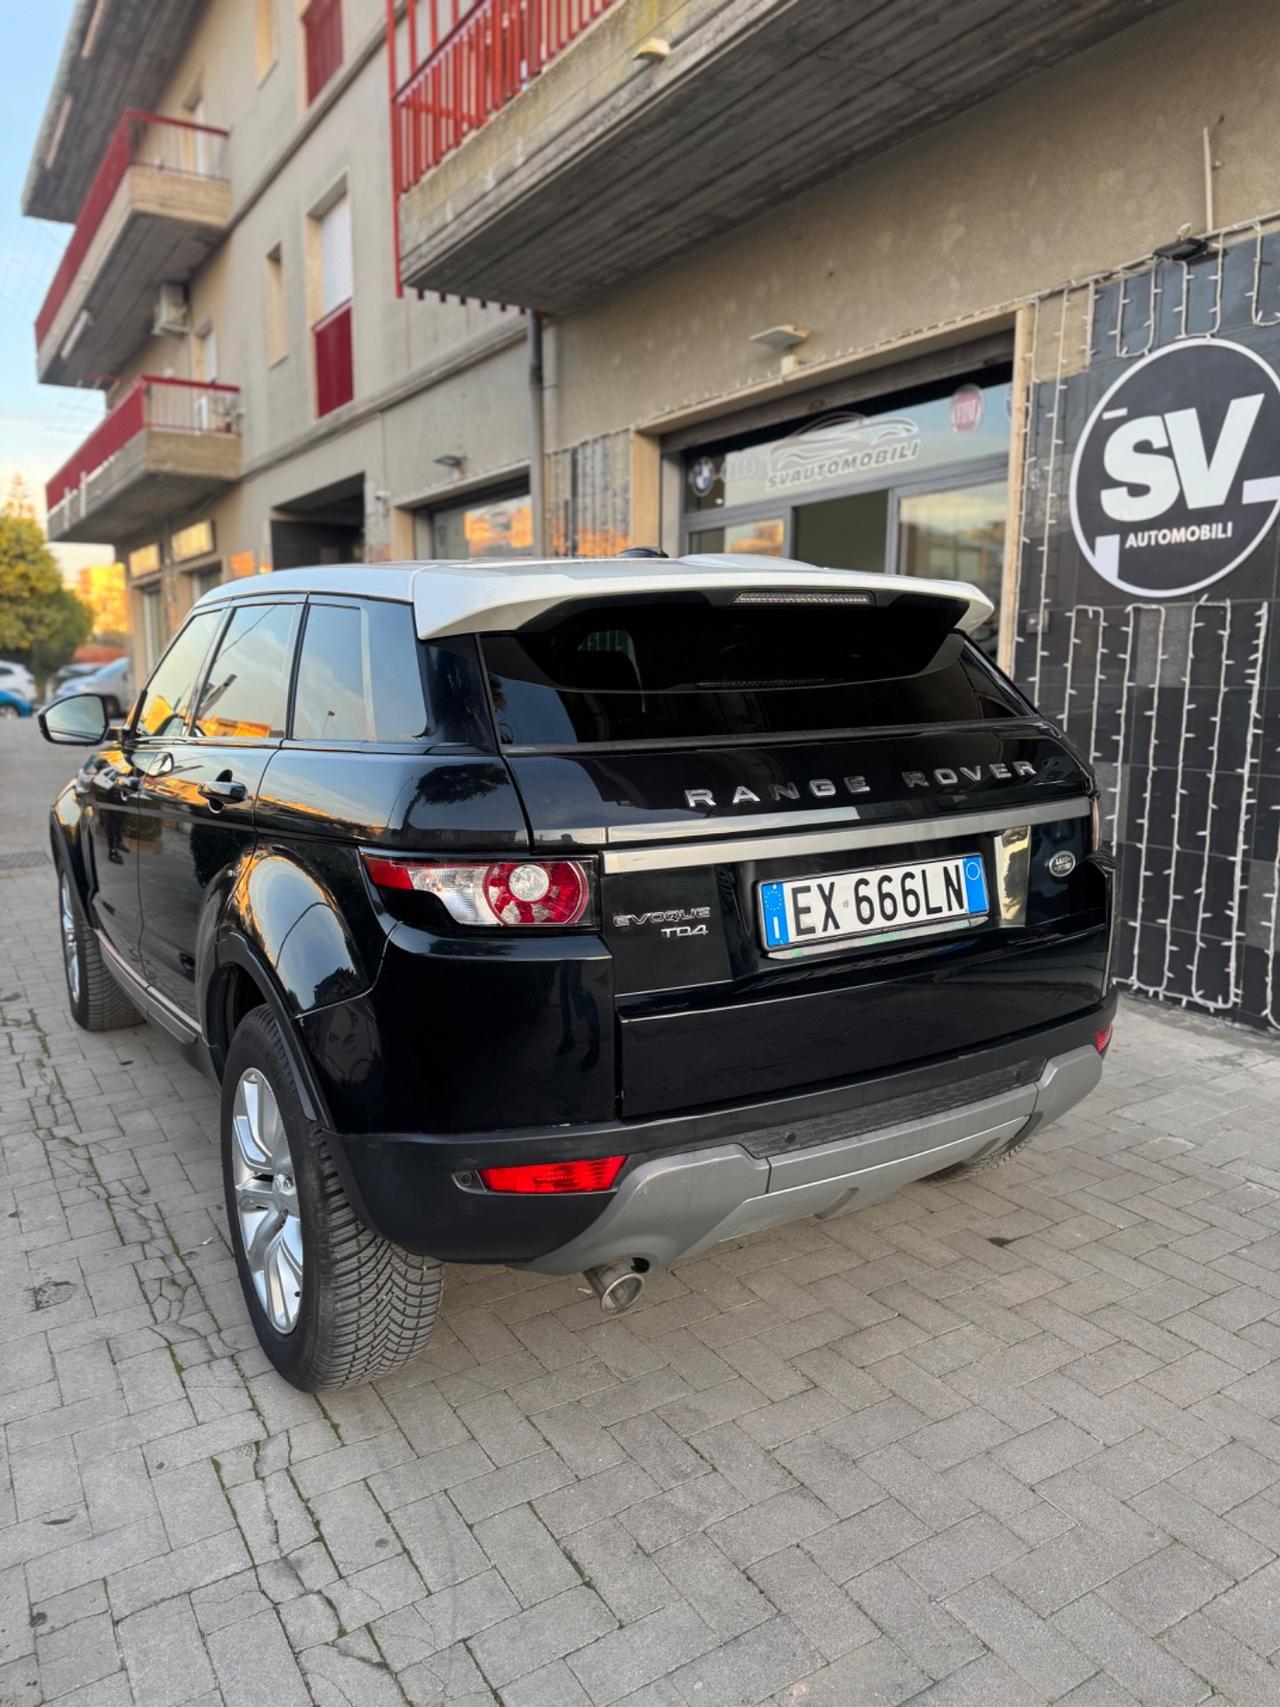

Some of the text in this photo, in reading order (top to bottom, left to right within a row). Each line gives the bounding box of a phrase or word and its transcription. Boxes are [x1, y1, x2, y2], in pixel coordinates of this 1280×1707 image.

[767, 440, 919, 488] SVAUTOMOBILI
[1101, 393, 1265, 522] SV
[1124, 521, 1233, 549] AUTOMOBILI
[684, 760, 1038, 808] RANGE ROVER
[613, 906, 711, 928] EVOQUE
[791, 864, 966, 937] EX 666LN
[660, 924, 709, 939] TD4
